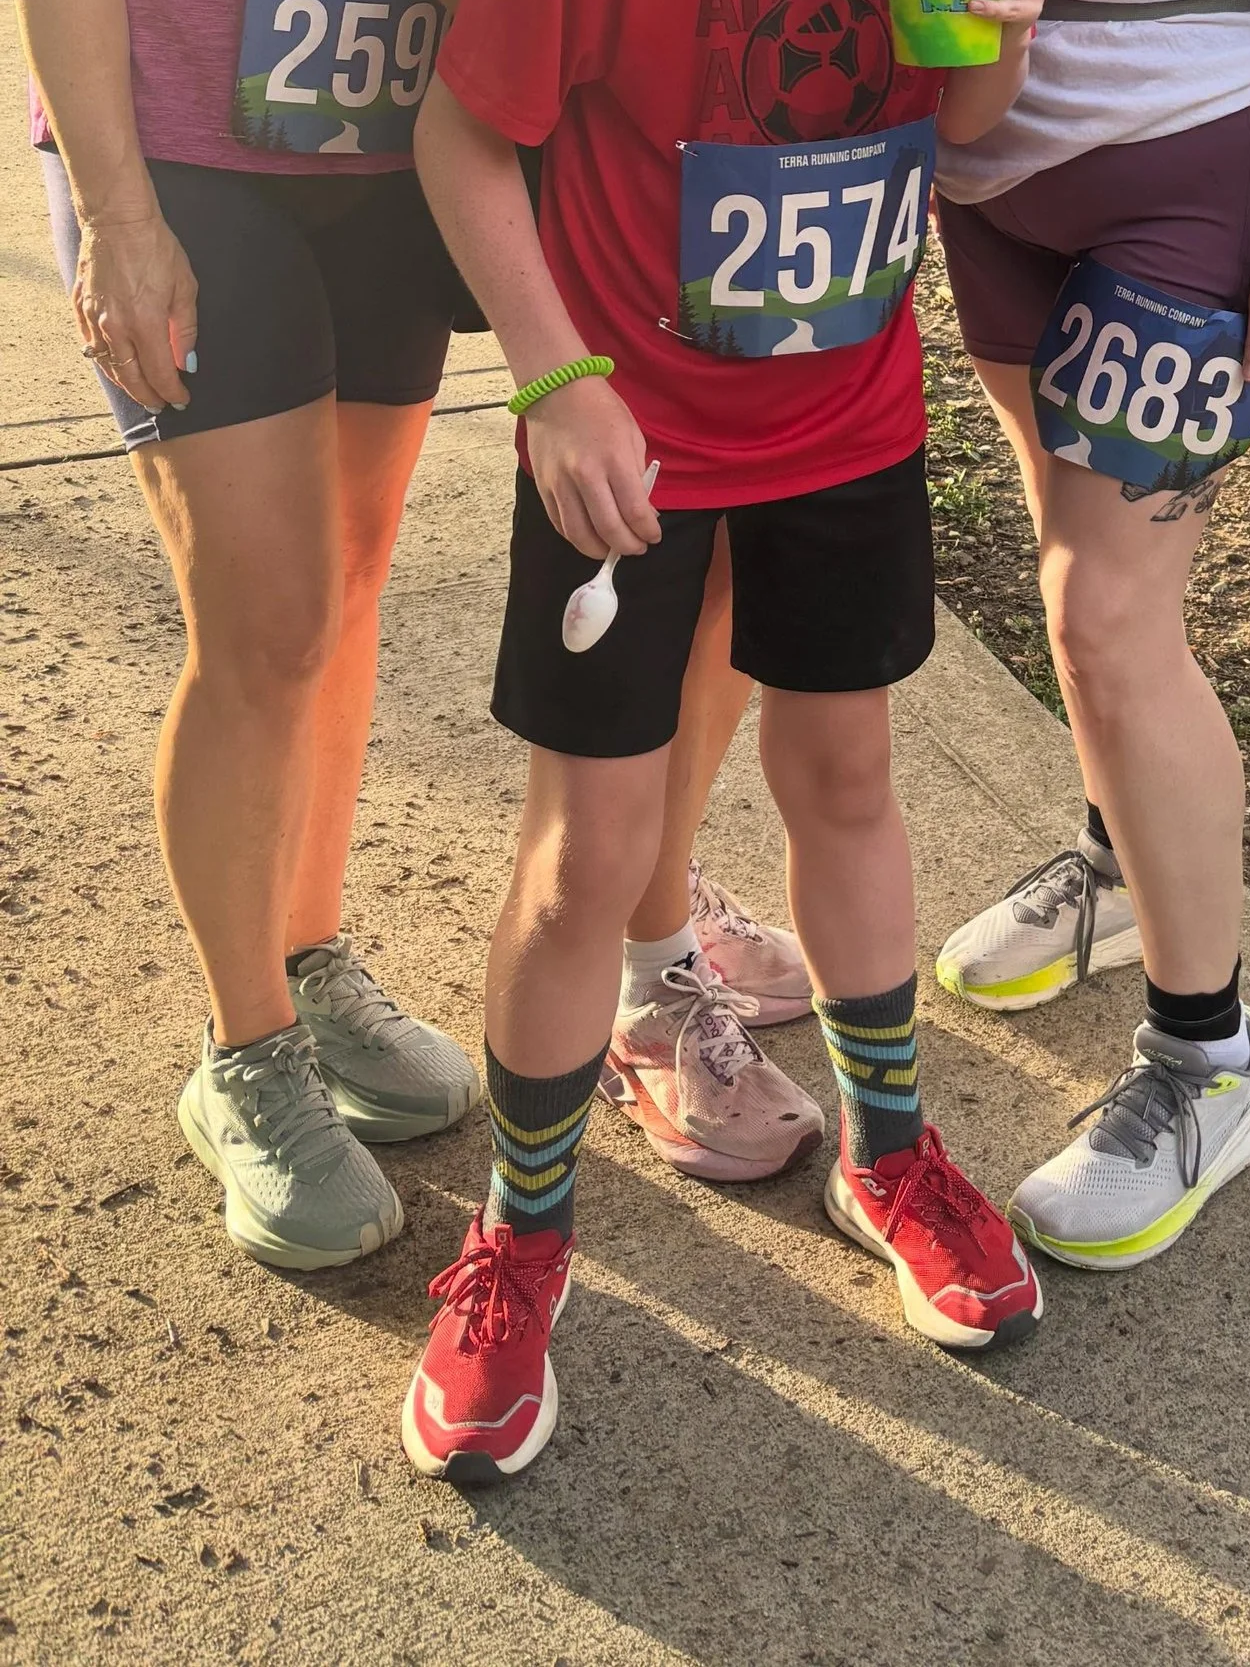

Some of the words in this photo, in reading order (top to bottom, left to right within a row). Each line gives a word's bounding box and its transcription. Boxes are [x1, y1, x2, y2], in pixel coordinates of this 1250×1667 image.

[778, 154, 809, 170] TERRA
[811, 149, 850, 166] RUNNING
[851, 141, 887, 161] COMPANY
[710, 166, 922, 308] 2574
[1113, 284, 1136, 304] TERRA
[1135, 294, 1168, 317] RUNNING
[1167, 307, 1208, 329] COMPANY
[1037, 302, 1245, 456] 2683
